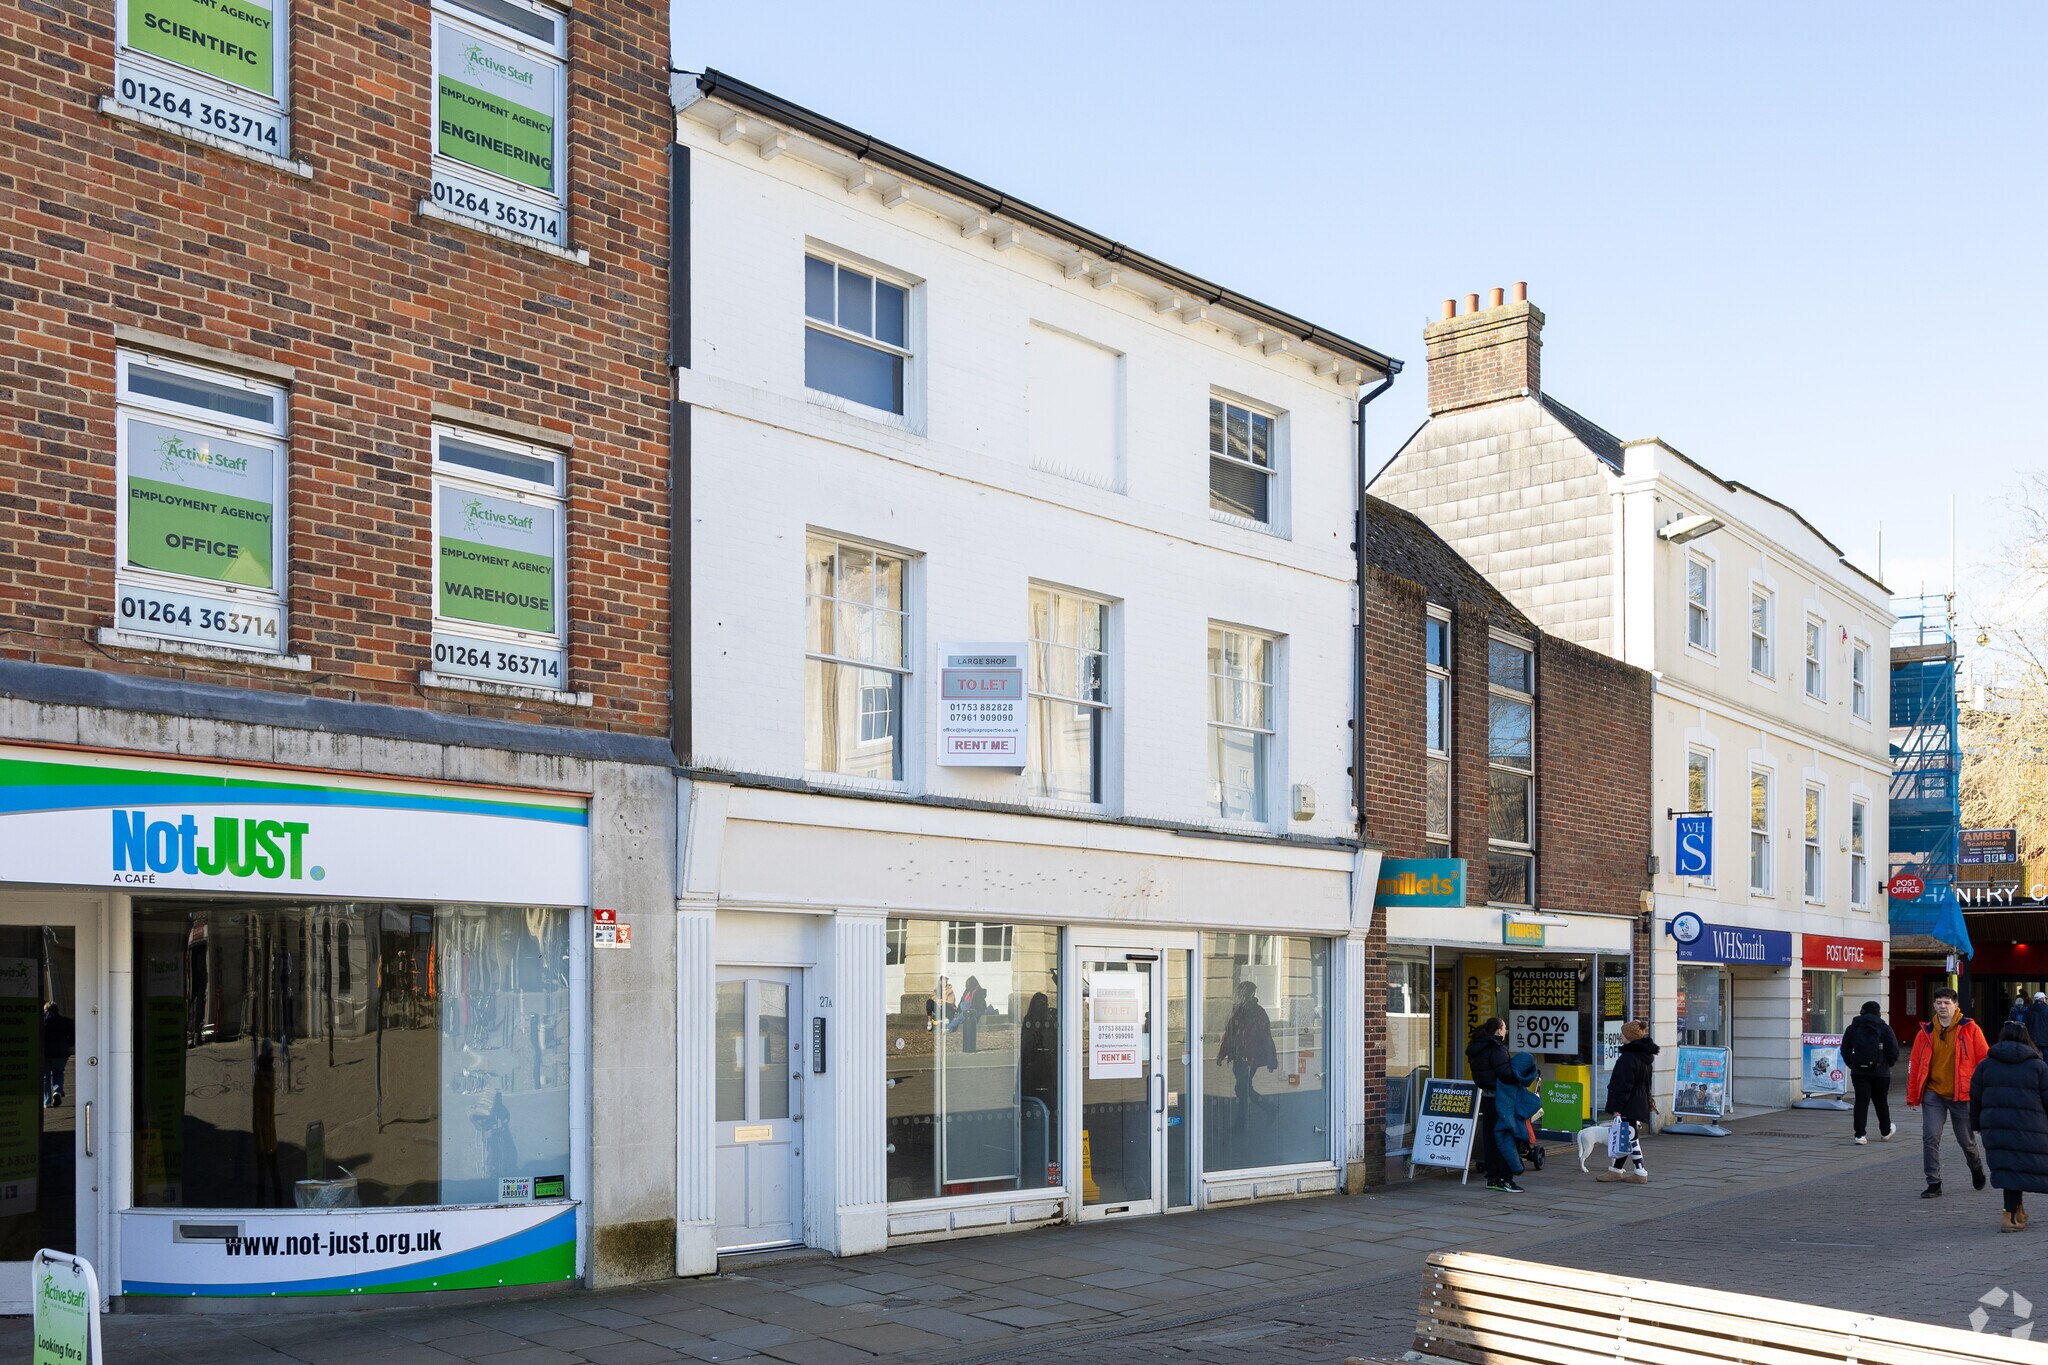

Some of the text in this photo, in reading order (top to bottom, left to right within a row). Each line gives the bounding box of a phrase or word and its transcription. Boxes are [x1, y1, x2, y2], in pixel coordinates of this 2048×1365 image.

[220, 4, 271, 30] AGENCY
[144, 12, 258, 65] SCIENTIFIC
[470, 50, 506, 75] Active
[507, 65, 534, 85] Staff
[121, 78, 278, 146] 01264 363714
[440, 85, 552, 134] EMPLOYMENT AGENCY
[440, 119, 552, 171] ENGINEERING
[433, 181, 558, 238] 01264 363714
[168, 443, 248, 472] Active Staff
[131, 488, 270, 523] EMPLOYMENT AGENCY
[470, 506, 533, 530] Active Staff
[165, 532, 239, 559] OFFICE
[441, 547, 552, 575] EMPLOYMENT AGENCY
[444, 581, 549, 611] WAREHOUSE
[121, 596, 277, 639] 01264 363714
[434, 643, 559, 679] 01264 363714
[958, 679, 1008, 691] TO LET
[950, 703, 1014, 712] 01753 882828
[950, 713, 1014, 722] 07961 909090
[955, 741, 1009, 750] RENT ME
[1681, 822, 1706, 833] WH
[1963, 831, 2011, 841] AMBER
[1681, 833, 1707, 872] S
[113, 873, 156, 884] A CAFÉ
[1377, 872, 1454, 895] millets
[1895, 879, 1917, 887] POST
[1891, 886, 1920, 894] OFFICE
[1713, 930, 1766, 960] WHSmith
[1826, 945, 1864, 963] POST OFFICE
[1513, 971, 1575, 979] WAREHOUSE
[1513, 979, 1575, 988] CLEARANCE
[1513, 988, 1575, 997] CLEARANCE
[1513, 997, 1575, 1006] CLEARANCE
[1517, 1015, 1525, 1048] UP TO
[1526, 1015, 1569, 1033] 60%
[1527, 1033, 1565, 1049] OFF
[1803, 1036, 1822, 1044] Half
[1101, 1053, 1132, 1061] RENT ME
[1431, 1093, 1472, 1101] CLEARANCE
[1430, 1105, 1470, 1113] CLEARANCE
[1425, 1121, 1435, 1146] UP TO
[1435, 1122, 1465, 1136] 60%
[1432, 1135, 1460, 1148] OFF
[503, 1189, 528, 1197] ANDOVER
[225, 1229, 442, 1257] www.not-just.org.uk
[44, 1282, 85, 1308] Active Staff
[38, 1334, 64, 1359] Looking
[65, 1344, 76, 1359] for
[77, 1352, 83, 1361] a
